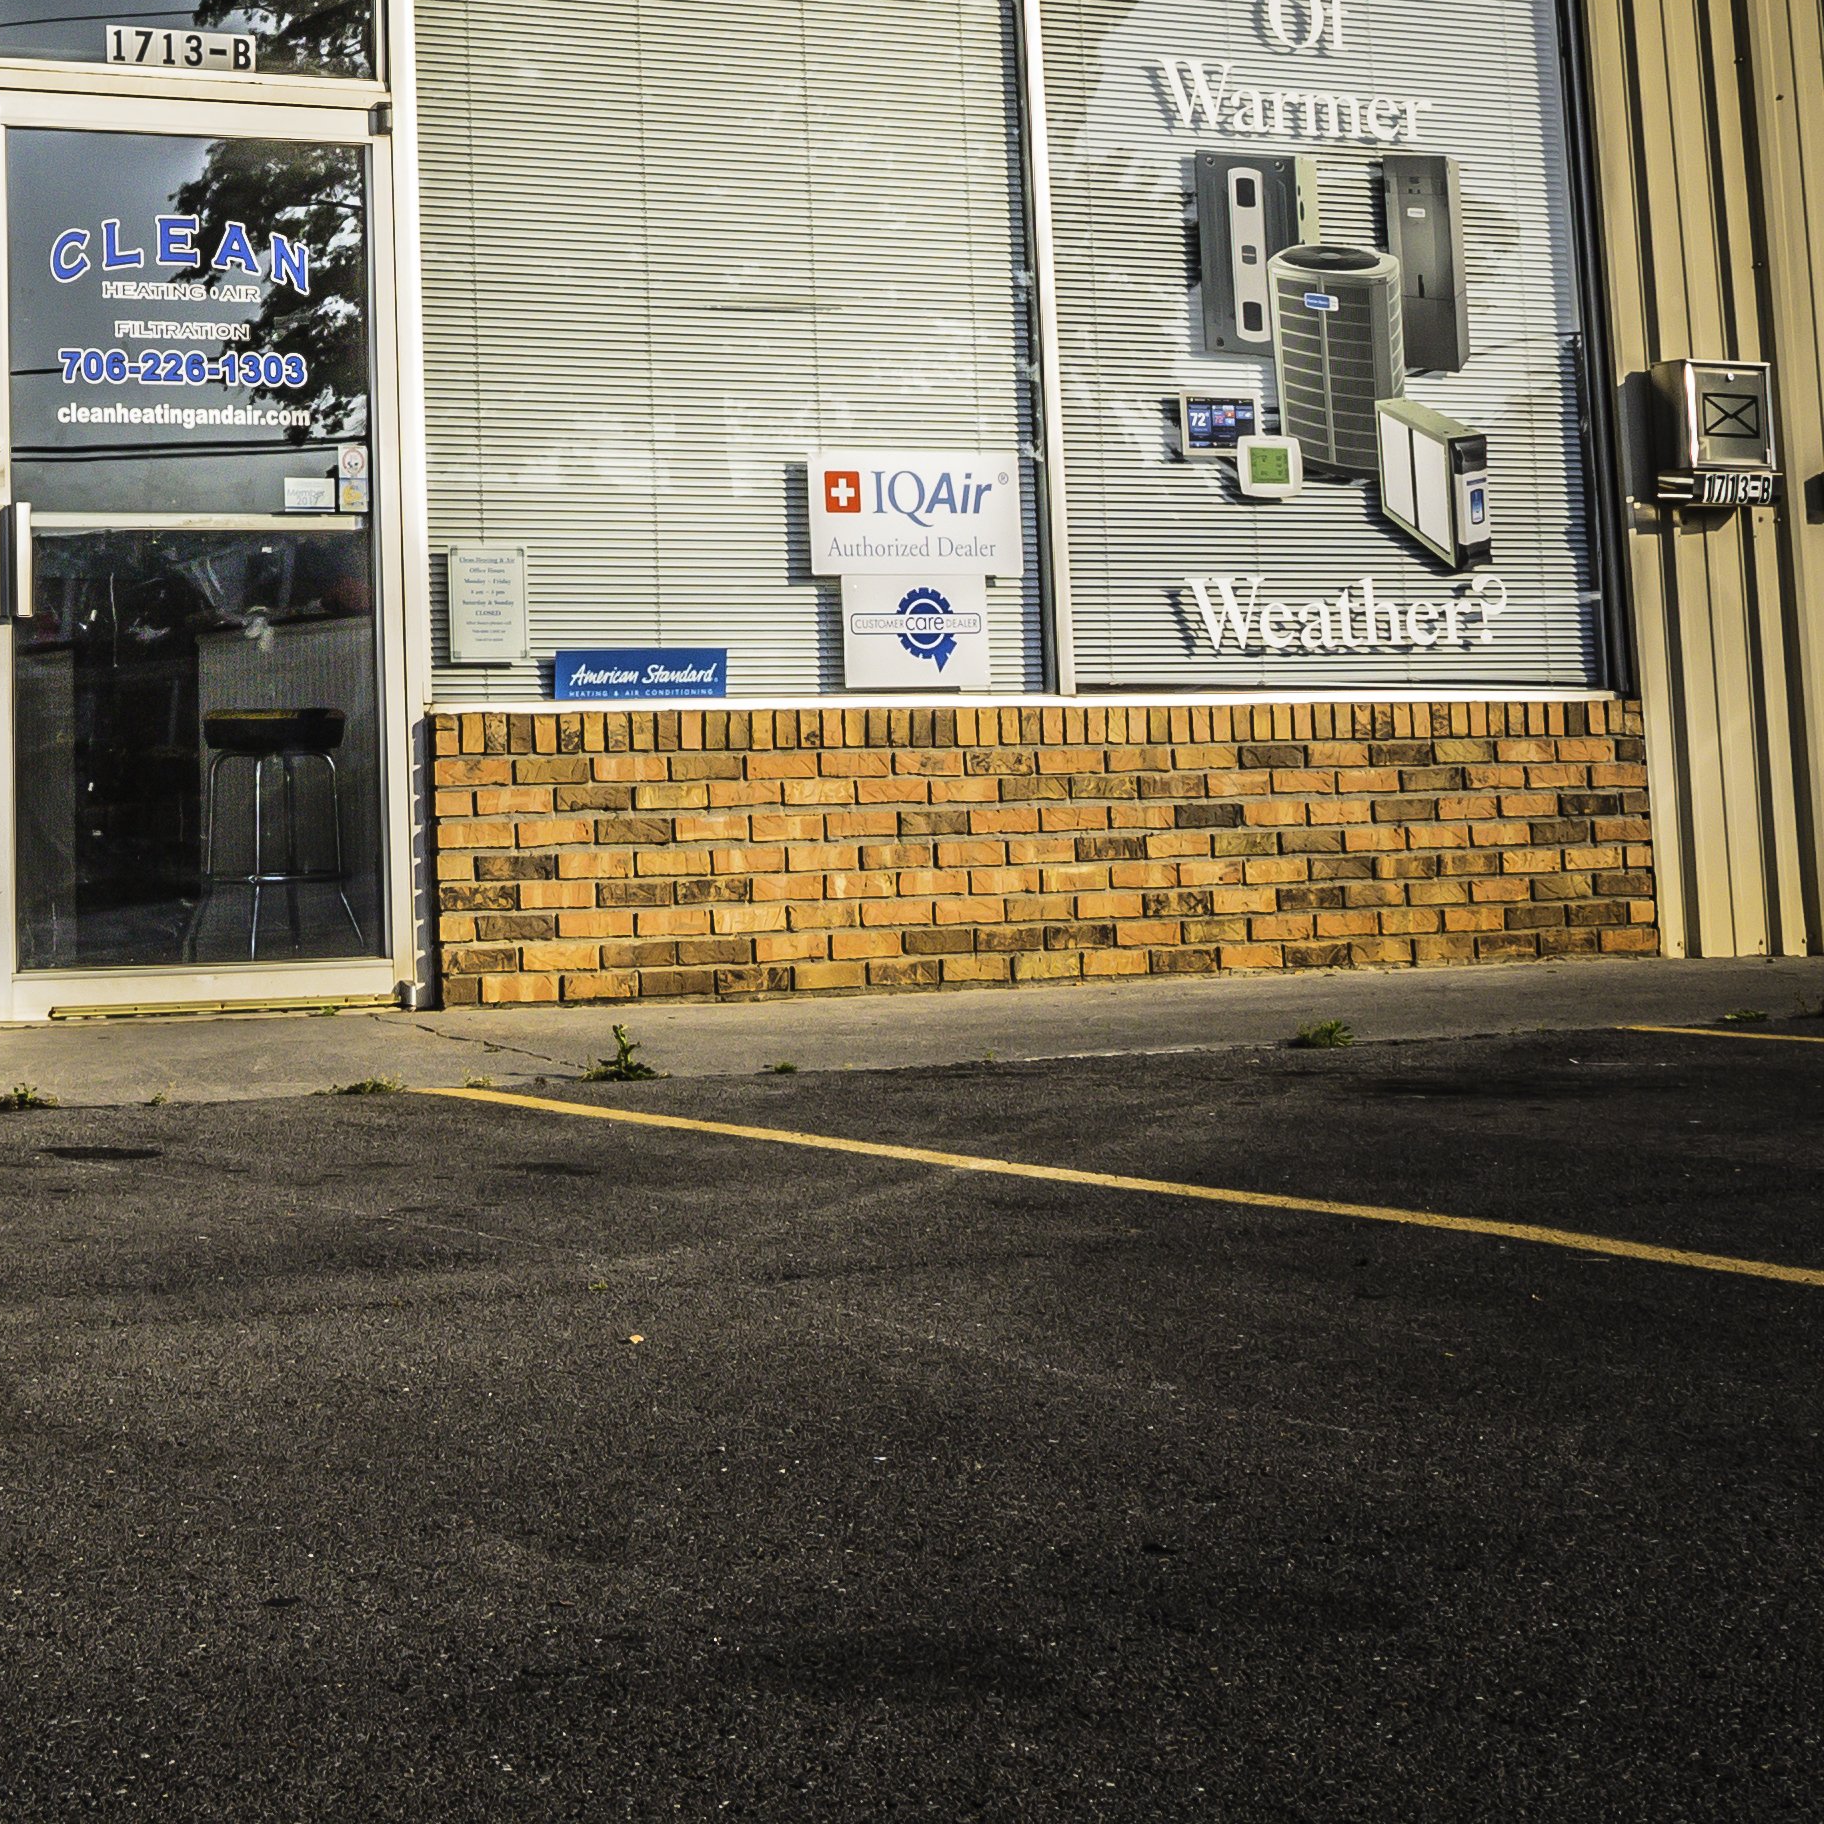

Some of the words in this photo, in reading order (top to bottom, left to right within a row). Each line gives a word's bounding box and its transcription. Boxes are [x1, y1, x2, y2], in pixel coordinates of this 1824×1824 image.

[113, 29, 251, 71] 1713-B
[1157, 56, 1432, 142] Warmer
[50, 213, 309, 296] CLEAN
[102, 281, 205, 301] HEATING
[219, 284, 261, 303] AIR
[115, 320, 251, 340] FILTRATION
[58, 348, 308, 387] 706-226-1303
[57, 403, 311, 428] cleanheatingandair.com
[871, 470, 993, 527] IQAir
[1705, 475, 1772, 504] 1713-B
[828, 536, 929, 557] Authorized
[937, 536, 996, 557] Dealer
[855, 619, 904, 630] CUSTOMER
[905, 614, 944, 632] care
[945, 618, 977, 628] DEALER
[1185, 575, 1508, 651] Weather?
[569, 663, 639, 686] American
[642, 662, 717, 684] Standard
[645, 688, 713, 696] CONDITIONING
